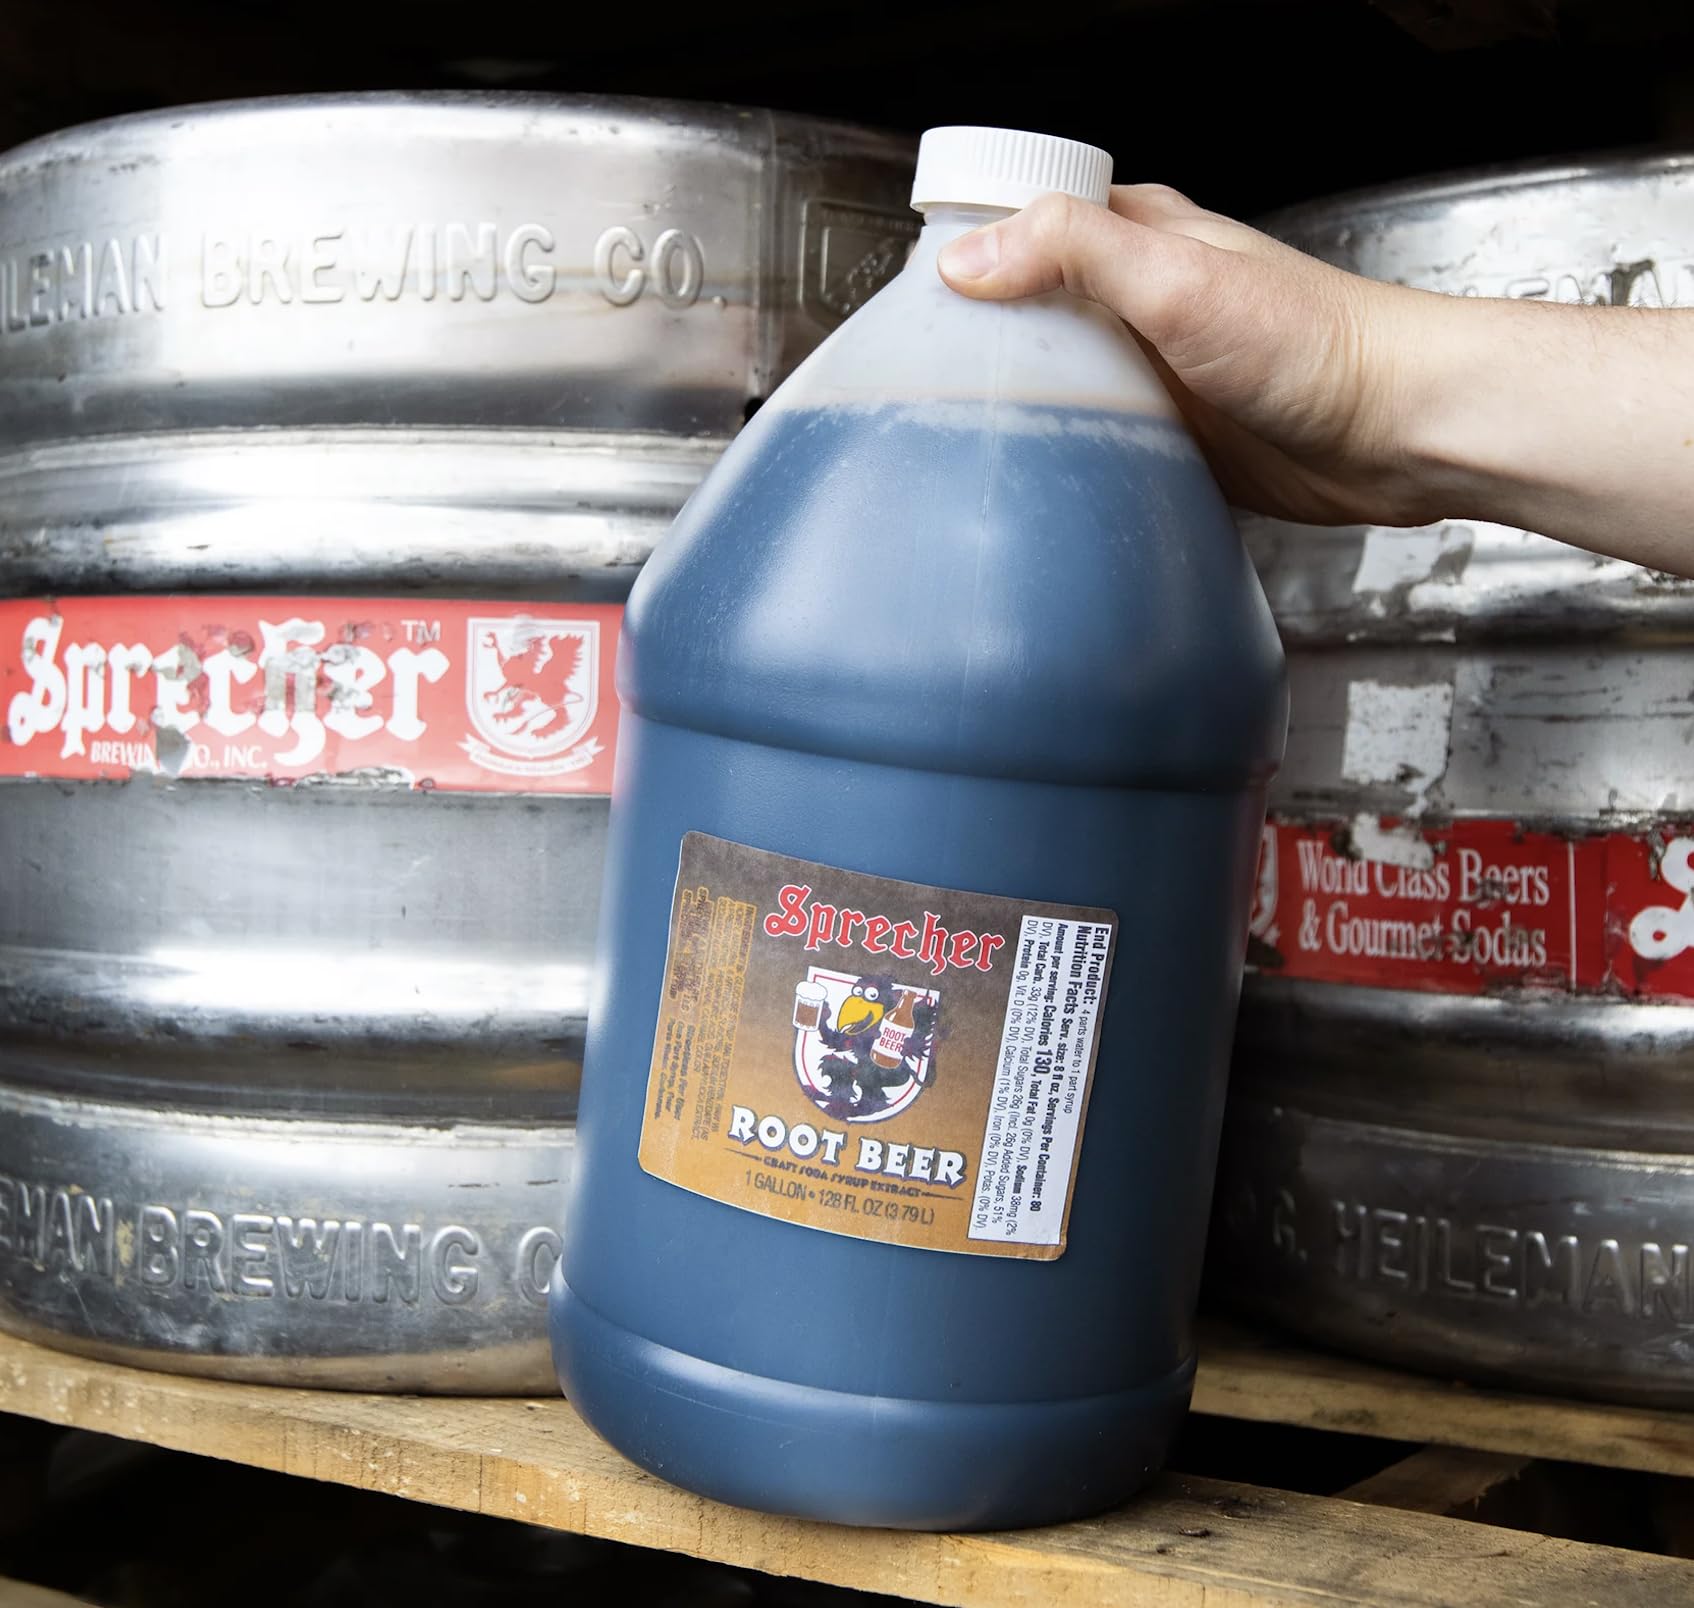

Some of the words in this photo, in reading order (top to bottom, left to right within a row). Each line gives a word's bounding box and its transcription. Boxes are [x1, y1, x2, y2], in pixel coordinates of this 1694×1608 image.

[200, 221, 556, 309] BREWING
[593, 224, 728, 311] CO.
[400, 619, 441, 644] TM
[223, 745, 268, 770] INC.
[1458, 848, 1551, 906] Beers
[763, 884, 1006, 976] Sprecher
[1053, 922, 1068, 954] Amount
[1092, 926, 1109, 949] End
[1298, 898, 1323, 952] &
[1326, 901, 1444, 961] Gourmet
[1450, 909, 1548, 968] Sodas
[1019, 938, 1034, 968] Protein
[1036, 940, 1049, 961] Total
[1069, 925, 1092, 978] Nutrition
[1032, 962, 1046, 984] Carb.
[1048, 955, 1060, 970] per
[1043, 969, 1060, 1003] serving:
[1083, 952, 1104, 1005] Product:
[1027, 985, 1042, 1001] 33g
[1063, 980, 1083, 1015] Facts
[1007, 1007, 1023, 1024] (0%
[1023, 1002, 1039, 1025] (12%
[1037, 1004, 1057, 1046] Calories
[883, 1027, 906, 1042] ROOT
[1058, 1017, 1073, 1041] Serv.
[1075, 1016, 1088, 1035] parts
[879, 1037, 903, 1052] BEER
[1018, 1045, 1032, 1064] Total
[1054, 1042, 1069, 1063] size:
[1073, 1036, 1085, 1058] water
[1000, 1044, 1016, 1077] Calcium
[1030, 1047, 1053, 1078] 130,
[1071, 1058, 1081, 1068] to
[1011, 1064, 1028, 1093] Sugars
[1028, 1079, 1042, 1099] Total
[1066, 1076, 1078, 1091] part
[1008, 1093, 1023, 1109] 26g
[1025, 1100, 1038, 1114] Fat
[1061, 1092, 1075, 1113] syrup
[991, 1115, 1004, 1131] Iron
[1023, 1115, 1035, 1126] 0g
[1040, 1096, 1059, 1135] Servings
[727, 1104, 847, 1166] ROOT
[854, 1135, 968, 1189] BEER
[986, 1132, 1001, 1149] (0%
[1002, 1132, 1016, 1147] 26g
[1018, 1127, 1033, 1144] (0%
[1039, 1136, 1052, 1151] Per
[999, 1148, 1014, 1173] Added
[981, 1169, 995, 1192] Potas.
[1012, 1164, 1027, 1194] Sodium
[1031, 1153, 1049, 1198] Container:
[743, 1169, 752, 1185] 1
[753, 1173, 808, 1202] GALLON
[817, 1190, 842, 1209] 128
[862, 1198, 883, 1217] OZ
[975, 1195, 991, 1212] (0%
[991, 1205, 1004, 1224] 51%
[1006, 1195, 1021, 1217] 38mg
[139, 1205, 480, 1304] BREWING
[1333, 1200, 1692, 1320] HEILEMAN
